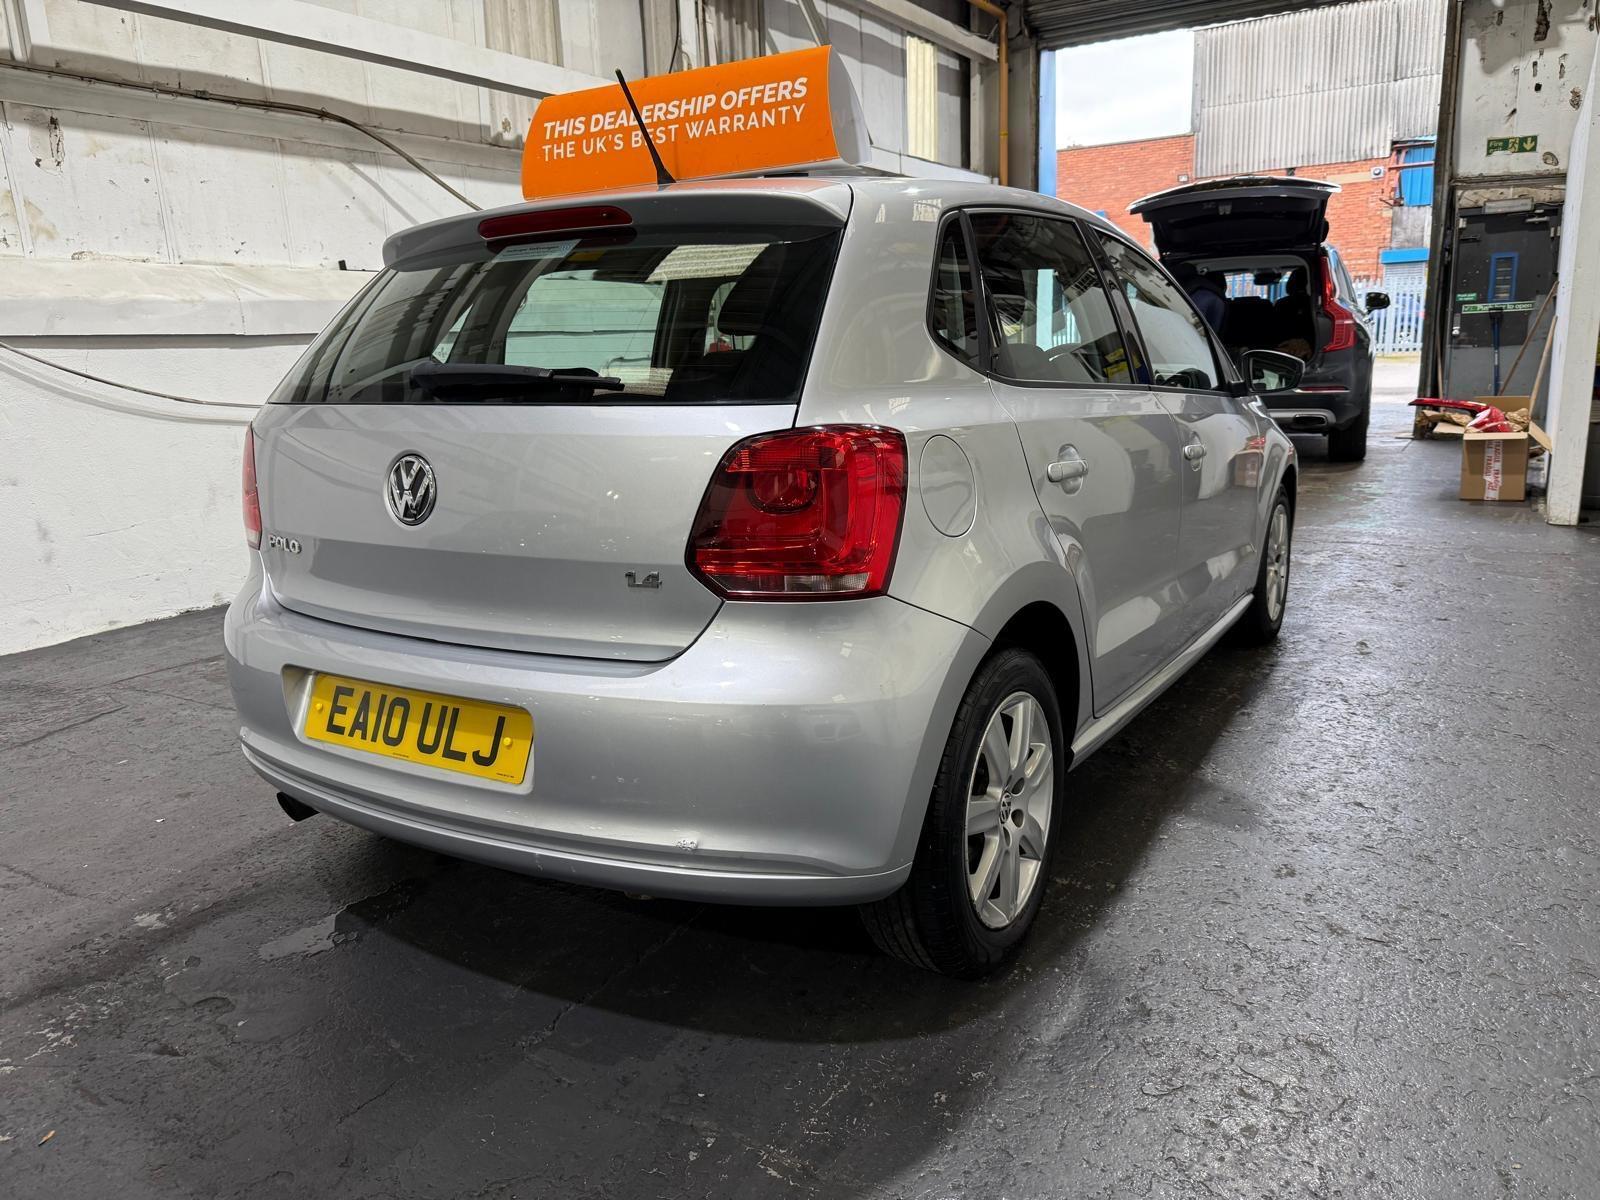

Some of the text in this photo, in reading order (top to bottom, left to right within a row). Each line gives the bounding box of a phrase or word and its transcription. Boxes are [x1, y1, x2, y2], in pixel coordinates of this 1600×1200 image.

[542, 141, 575, 161] THE
[582, 133, 624, 155] UK'S
[686, 103, 806, 140] WARRANTY
[543, 77, 807, 140] THIS DEALERSHIP OFFERS
[268, 534, 302, 555] POLO
[624, 569, 662, 589] 1.4
[326, 685, 505, 767] EA10 ULJ
